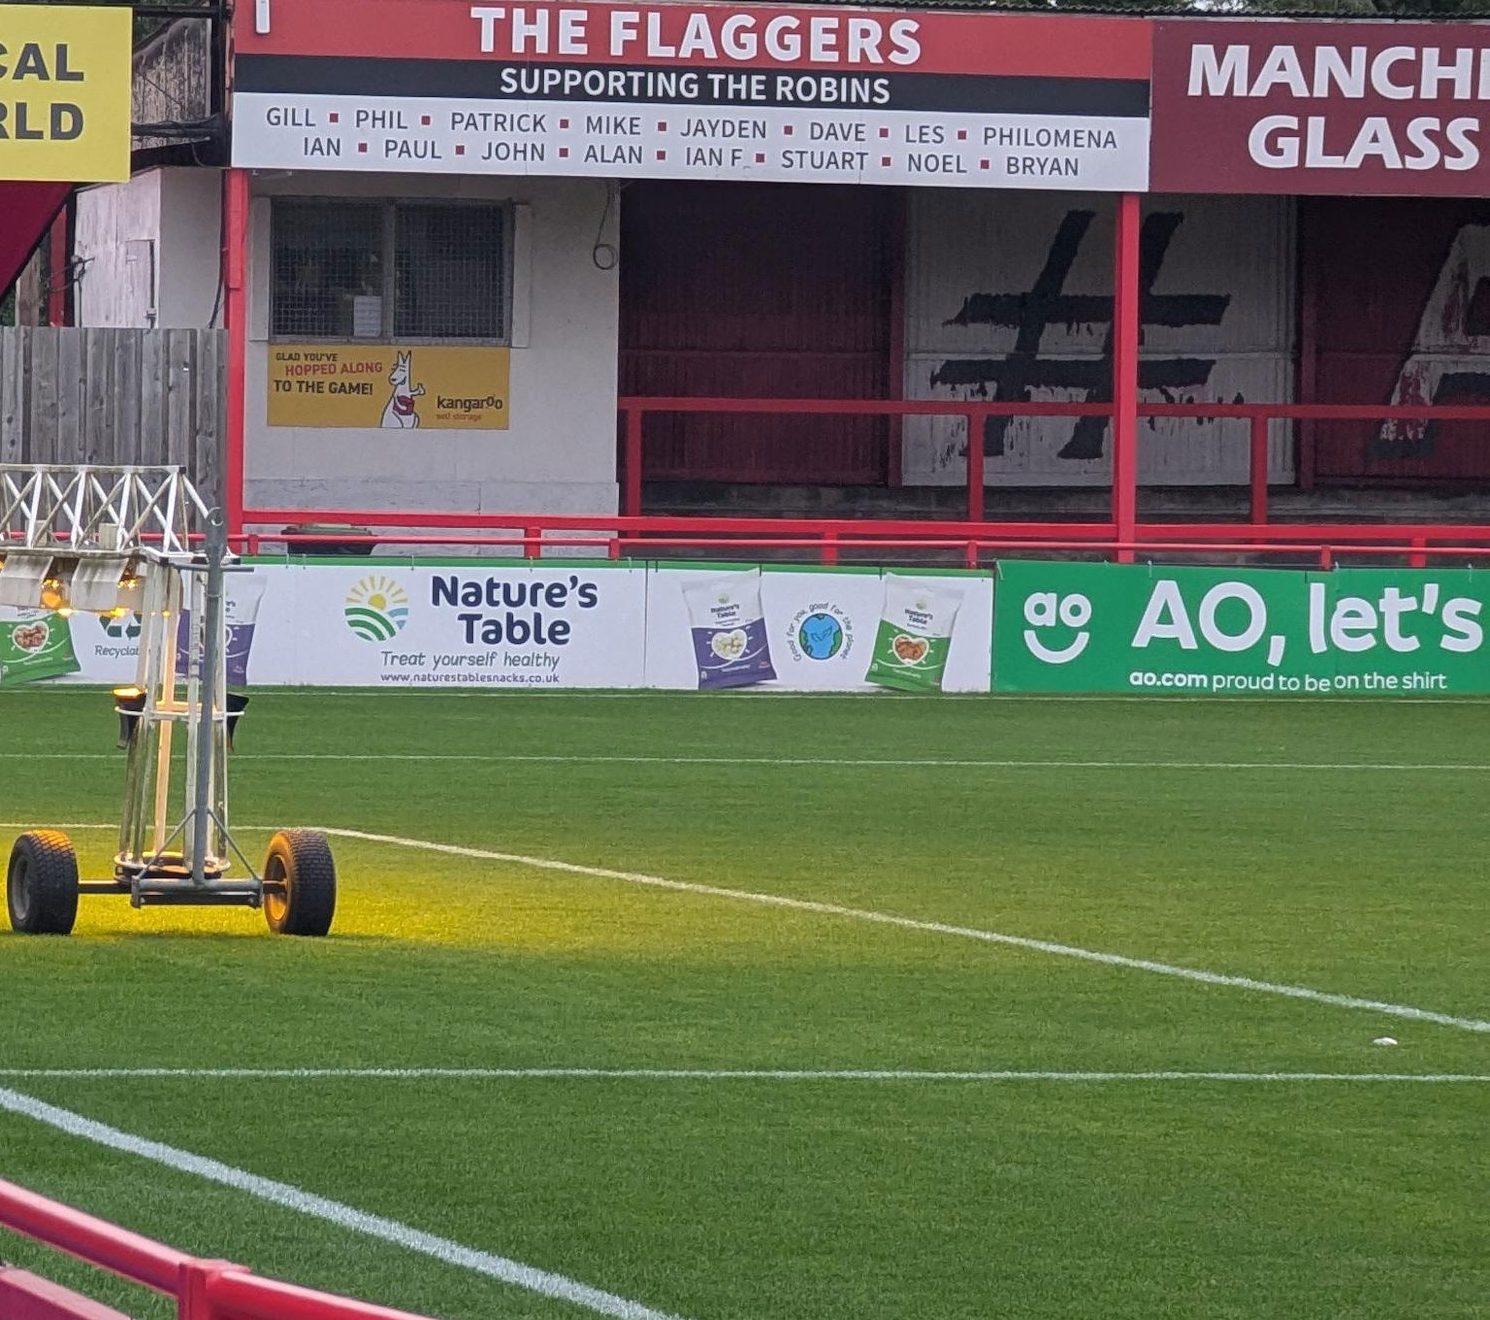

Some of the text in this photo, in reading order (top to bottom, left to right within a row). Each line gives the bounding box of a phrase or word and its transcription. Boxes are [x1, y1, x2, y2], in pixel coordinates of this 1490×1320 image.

[471, 7, 921, 65] THE FLAGGERS
[501, 68, 890, 104] SUPPORTING THE ROBINS
[1188, 44, 1490, 99] MANCH
[267, 107, 1117, 149] GILL PHIL PATRICK MIKE JAYDEN DAVE LES PHILOMENA
[1248, 115, 1480, 171] GLASS
[304, 137, 1079, 177] IAN PAUL JOHN ALAN IAN F STUART NOEL BRYAN
[276, 352, 338, 362] GLAD YOU'VE
[285, 362, 383, 376] HOPPED ALONG
[274, 380, 373, 395] TO THE GAME!
[437, 395, 503, 413] kangaroo
[432, 576, 597, 608] Nature's
[1024, 593, 1091, 627] ao
[1131, 580, 1483, 666] AO, let's
[458, 612, 571, 645] Table
[95, 644, 139, 659] Recycla
[381, 651, 560, 672] Treat yourself healthy
[381, 672, 560, 683] www.naturestablesnacks.co.uk
[1130, 671, 1448, 693] ao.com proud to be on the shirt
